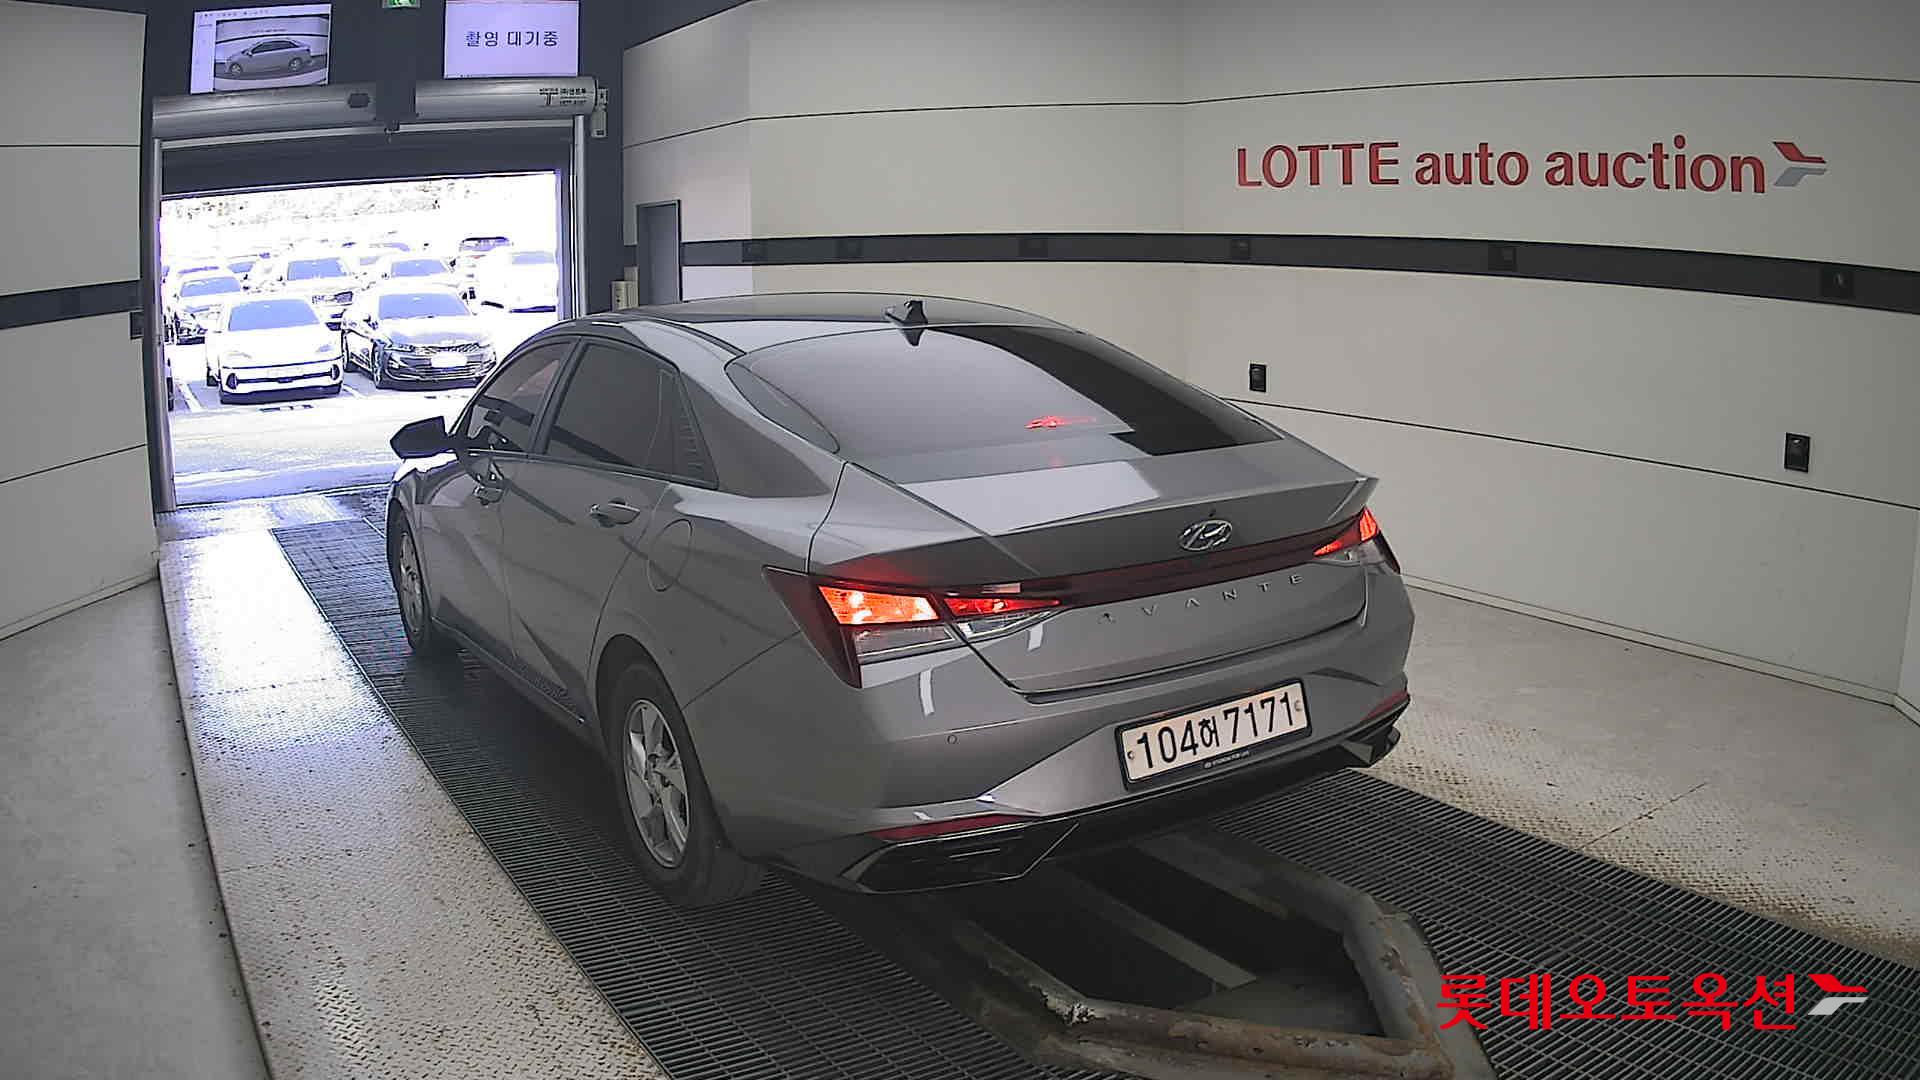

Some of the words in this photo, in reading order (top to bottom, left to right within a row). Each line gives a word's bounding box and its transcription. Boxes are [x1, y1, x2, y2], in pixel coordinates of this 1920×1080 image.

[466, 31, 498, 47] 촬영
[507, 31, 558, 47] 대기중
[1236, 142, 1400, 188] LOTTE
[1415, 142, 1529, 186] auto
[1545, 134, 1766, 194] auction
[1099, 575, 1303, 624] AVANTE
